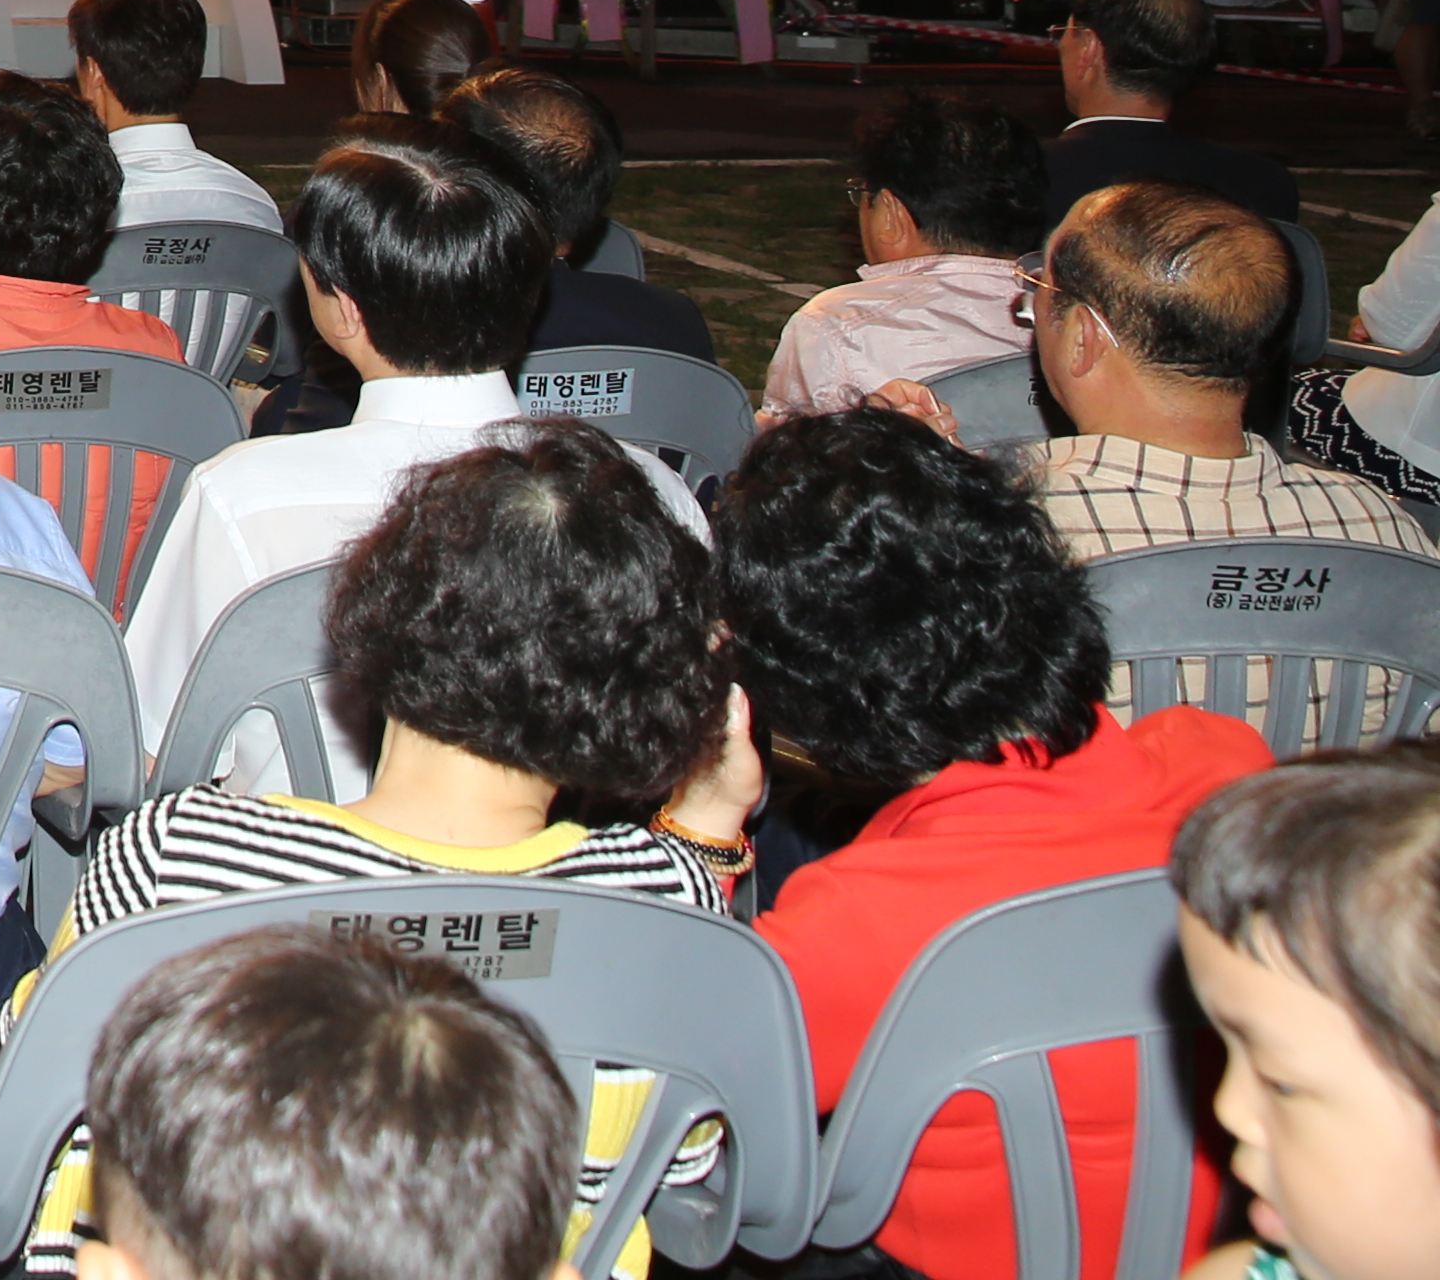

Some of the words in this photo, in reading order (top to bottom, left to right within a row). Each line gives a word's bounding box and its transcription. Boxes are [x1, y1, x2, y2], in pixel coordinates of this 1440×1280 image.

[526, 370, 629, 398] 태영렌탈
[1211, 564, 1332, 594] 금정사
[330, 912, 541, 953] 태영렌탈
